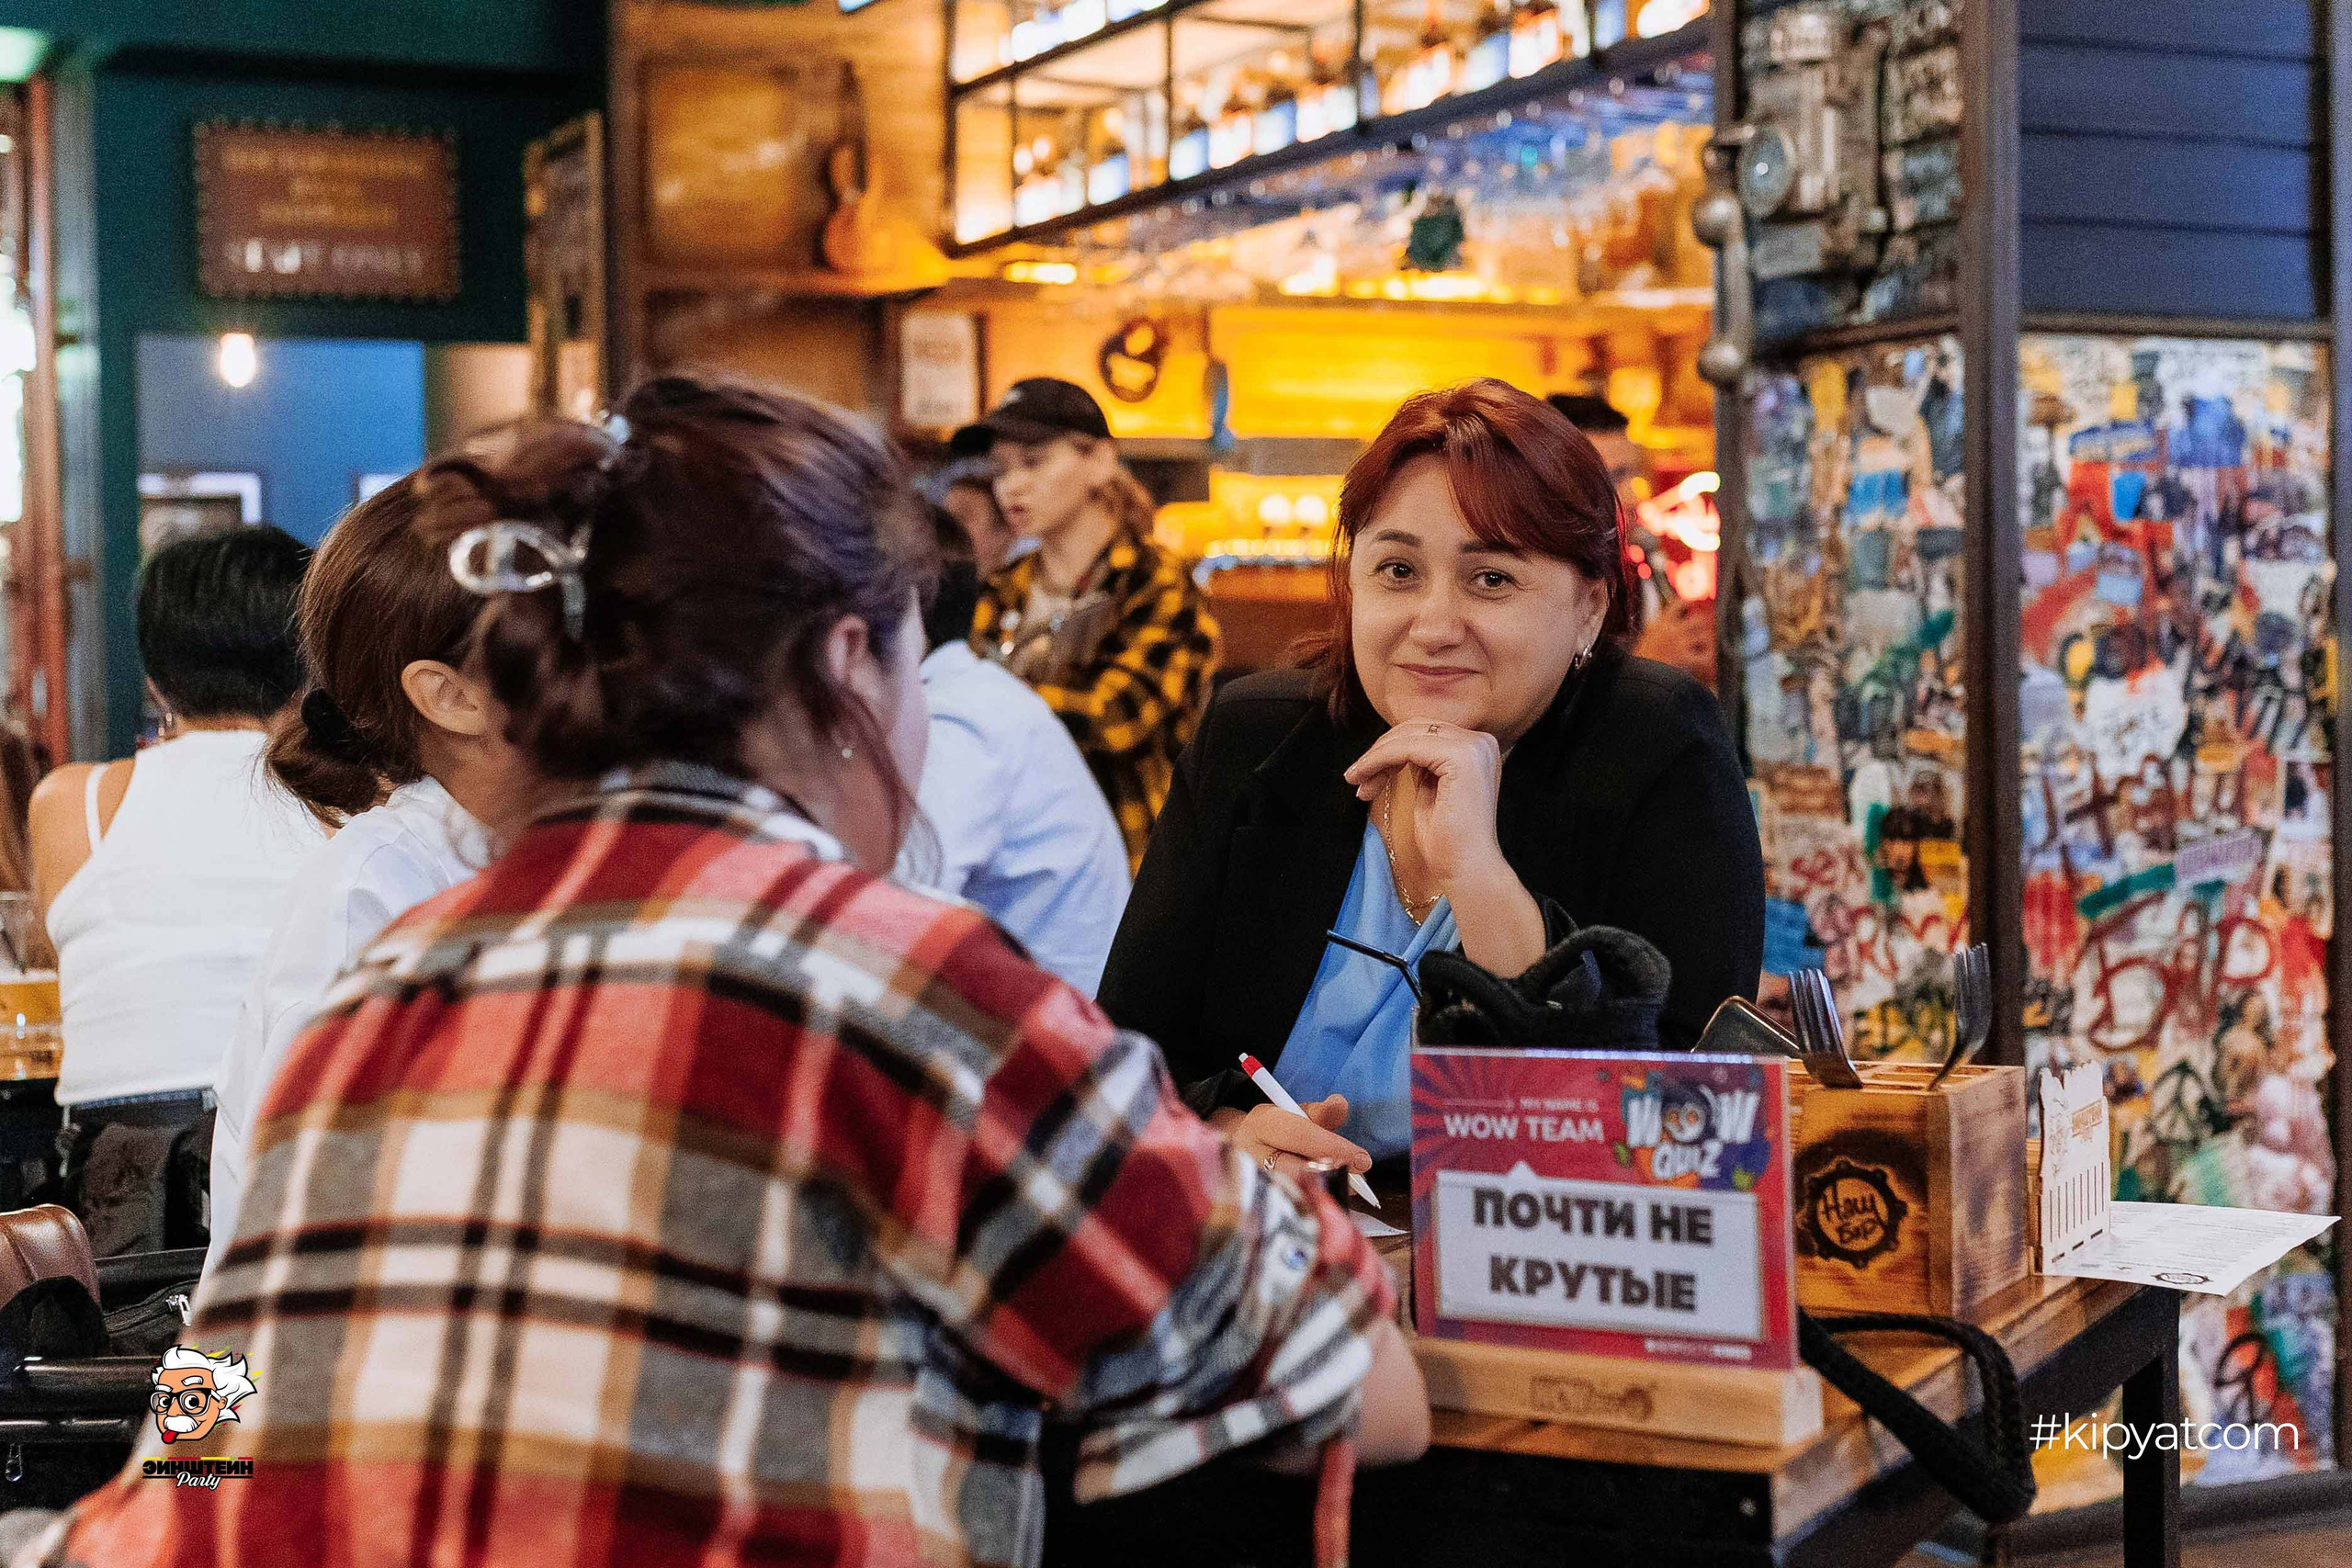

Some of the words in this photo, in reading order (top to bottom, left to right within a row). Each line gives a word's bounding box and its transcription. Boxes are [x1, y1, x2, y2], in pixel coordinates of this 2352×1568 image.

[1443, 1113, 1518, 1140] WOW
[1525, 1115, 1605, 1144] TEAM
[1473, 1186, 1636, 1241] ПОЧТИ
[1650, 1203, 1713, 1247] НЕ
[1489, 1256, 1698, 1313] КРУТЫЕ
